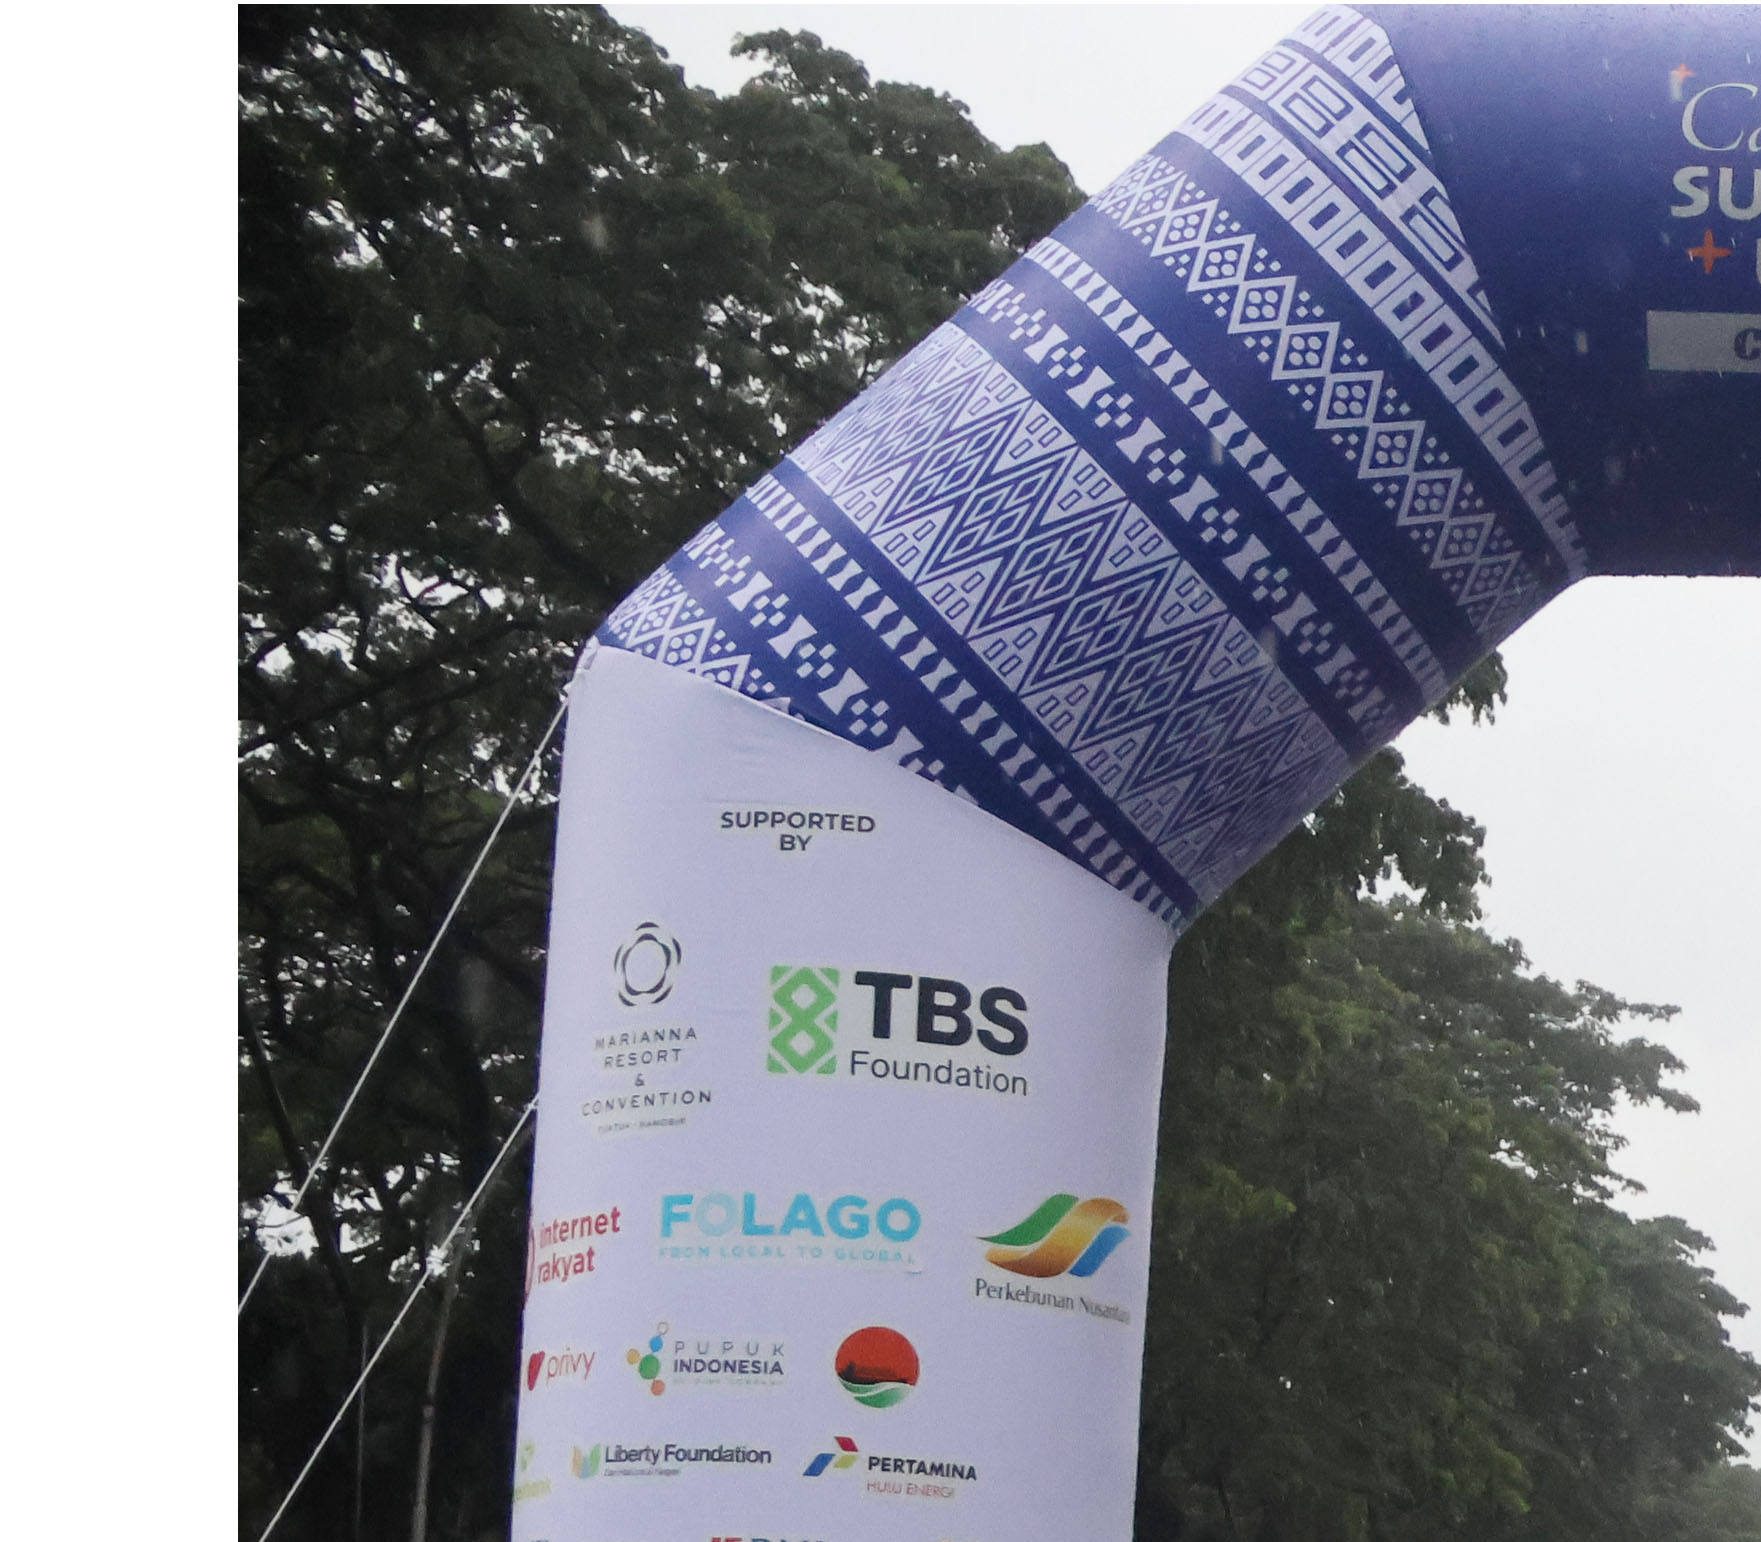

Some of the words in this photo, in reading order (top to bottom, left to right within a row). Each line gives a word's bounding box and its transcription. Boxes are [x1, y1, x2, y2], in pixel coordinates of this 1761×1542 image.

[720, 810, 876, 833] SUPPORTED
[779, 834, 812, 852] BY
[853, 970, 1029, 1056] TBS
[595, 1027, 697, 1049] MARIANNA
[604, 1048, 682, 1068] RESORT
[634, 1073, 645, 1086] &
[850, 1050, 1028, 1097] Foundation
[582, 1090, 712, 1116] CONVENTION
[539, 1206, 621, 1249] internet
[660, 1193, 921, 1242] FOLAGO
[537, 1247, 596, 1284] rakyat
[975, 1278, 1074, 1311] Perkebunan
[674, 1341, 785, 1356] PUPUK
[547, 1348, 596, 1380] privy
[673, 1359, 785, 1375] INDONESIA
[605, 1446, 660, 1465] Liberty
[664, 1444, 771, 1464] Foundation
[868, 1456, 977, 1481] PERTAMINA
